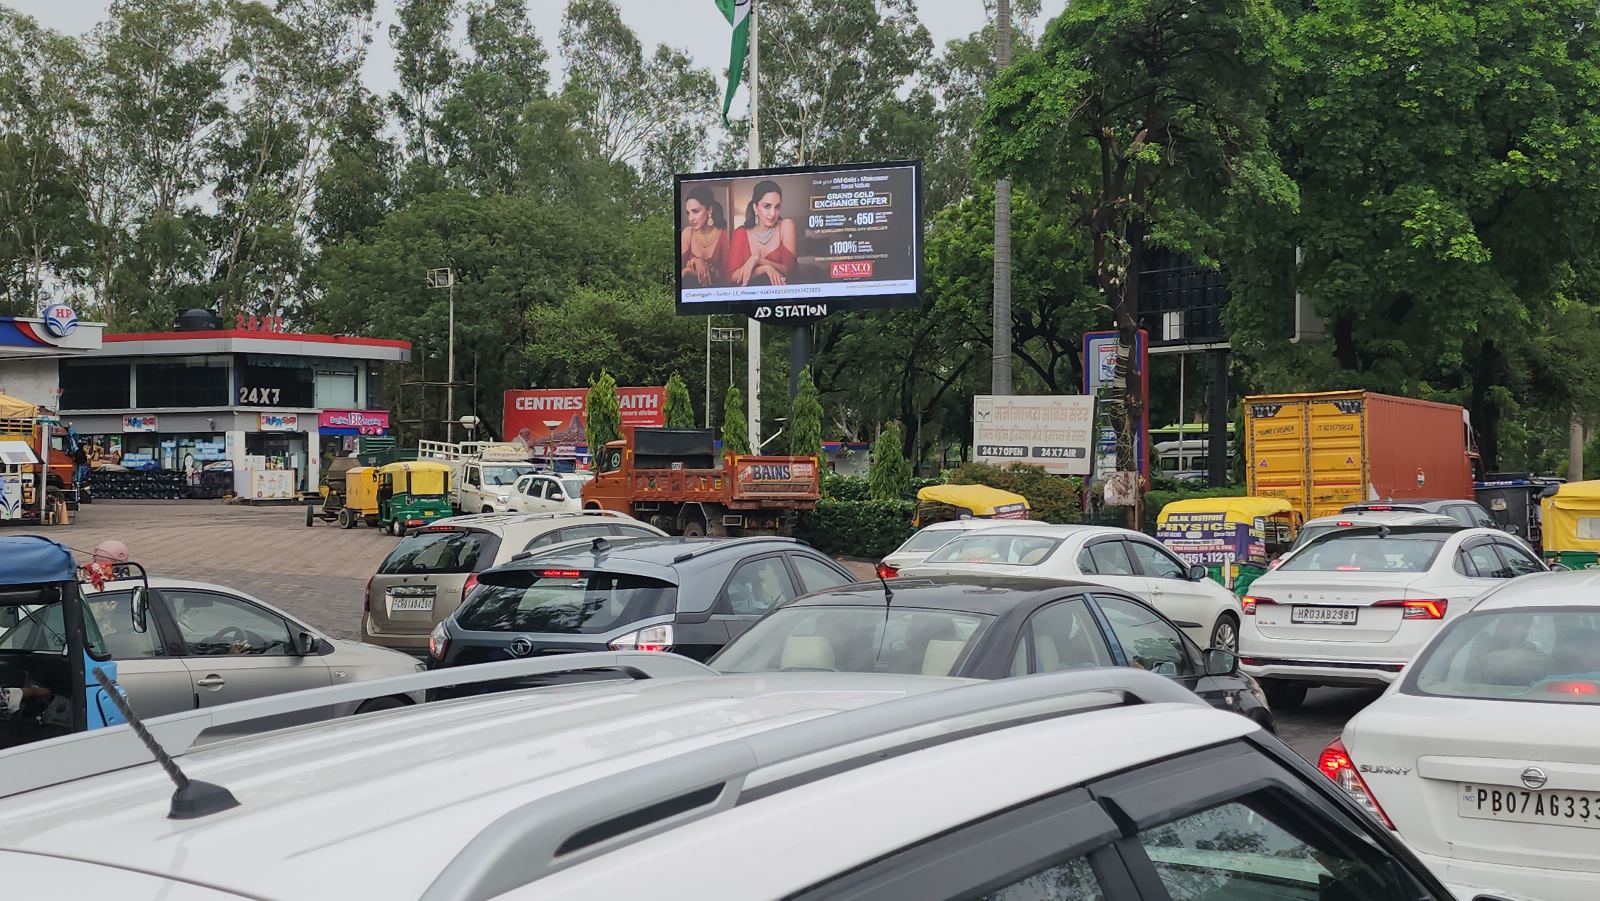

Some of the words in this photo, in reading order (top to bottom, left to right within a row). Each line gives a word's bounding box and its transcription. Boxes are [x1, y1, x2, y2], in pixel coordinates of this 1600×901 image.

[827, 192, 852, 200] GRAND
[854, 191, 874, 199] GOLD
[814, 199, 859, 208] EXCHANGE
[860, 197, 887, 206] OFFER
[808, 215, 824, 228] 0%
[833, 241, 857, 254] 100%
[56, 308, 72, 318] HP
[754, 306, 771, 318] AD
[775, 304, 827, 318] STATION
[239, 386, 280, 405] 24X7
[516, 396, 583, 411] CENTRES
[1004, 447, 1024, 456] OPEN
[1063, 449, 1077, 457] AIR
[752, 465, 791, 481] BAINS
[1157, 522, 1236, 532] PHYSICS
[1298, 610, 1355, 620] HR03AB2981
[1359, 764, 1413, 776] SUNNY
